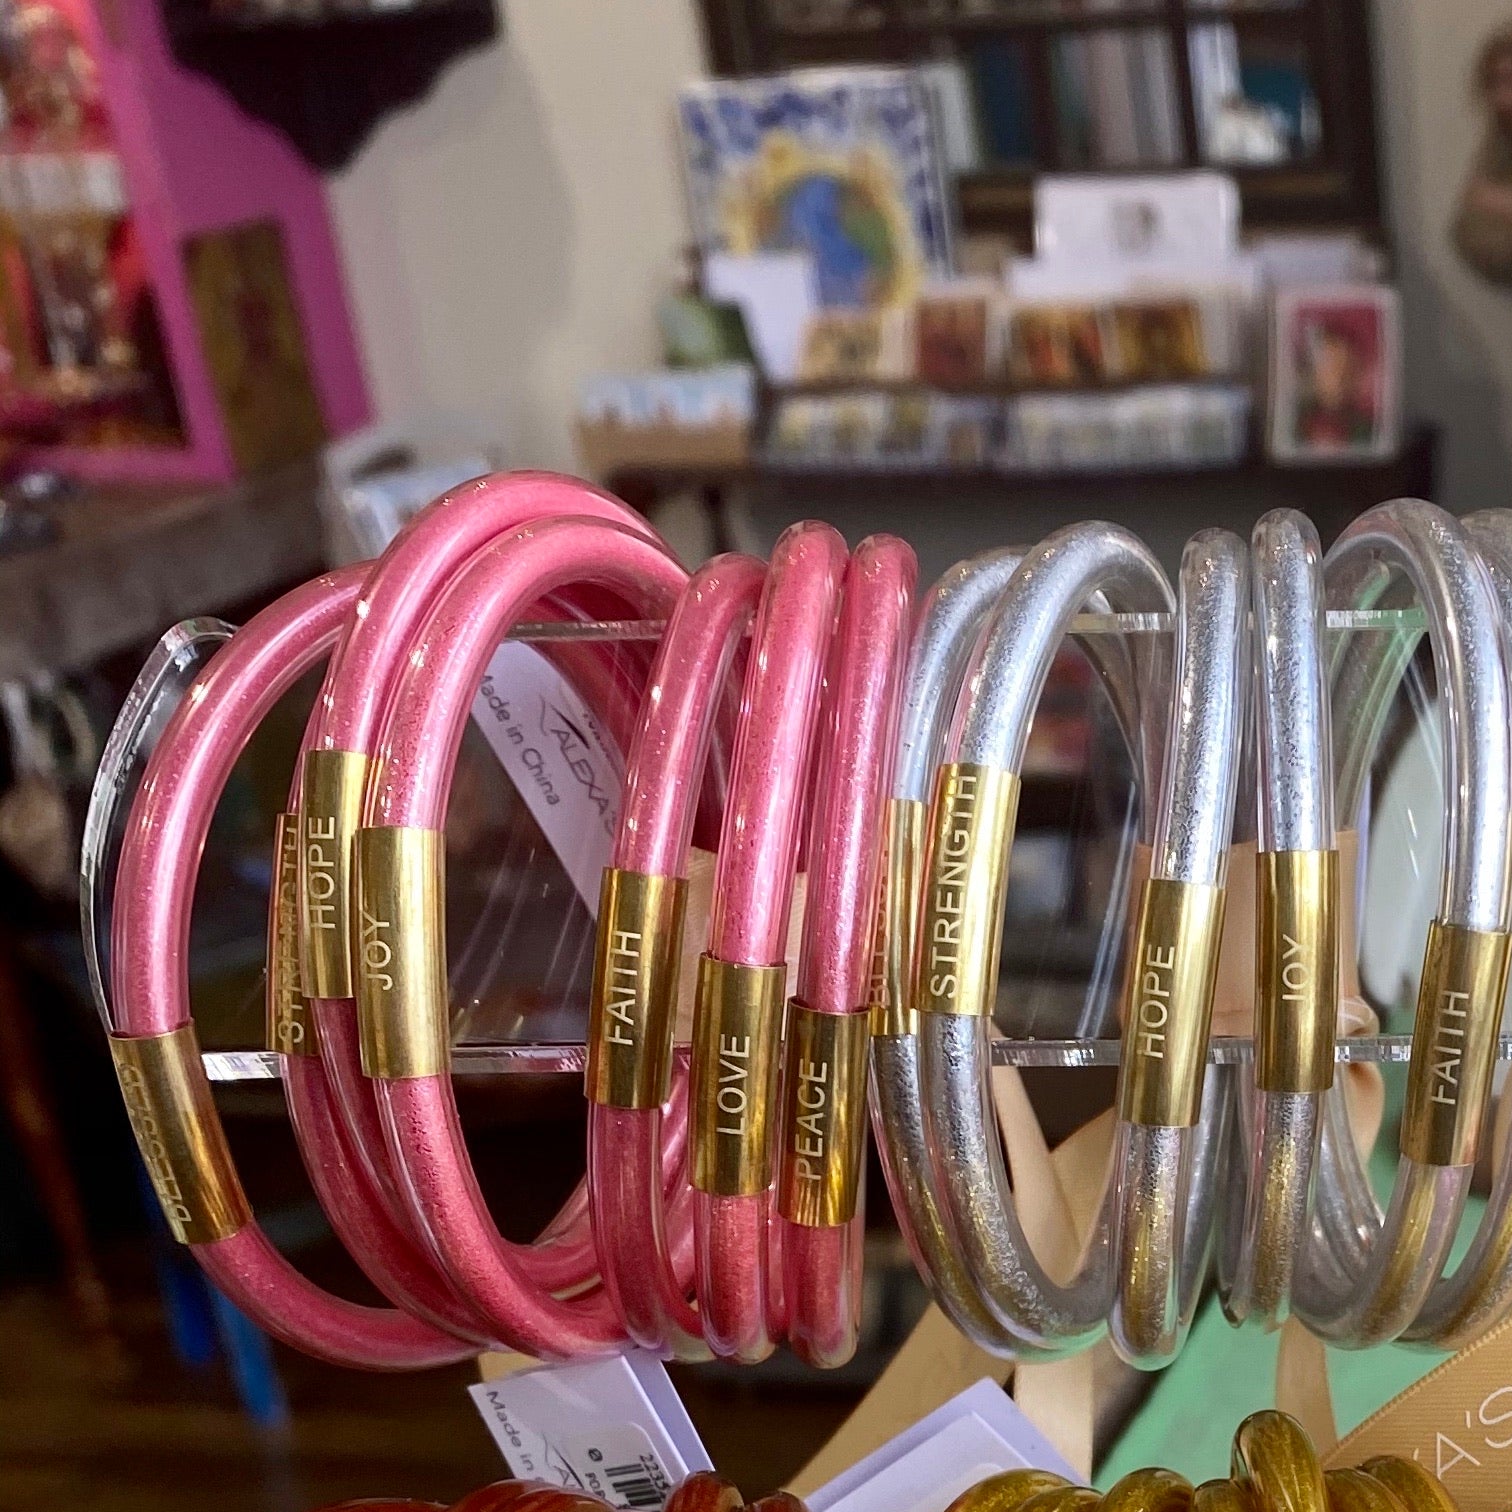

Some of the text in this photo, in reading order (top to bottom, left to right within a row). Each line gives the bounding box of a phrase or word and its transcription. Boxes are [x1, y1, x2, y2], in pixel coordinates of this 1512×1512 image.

[521, 747, 561, 807] China
[308, 815, 336, 929] HOPE
[929, 774, 978, 999] STRENGTH
[363, 909, 393, 992] JOY
[604, 930, 642, 1047] FAITH
[1137, 943, 1176, 1059] HOPE
[715, 1032, 751, 1136] LOVE
[1431, 990, 1470, 1105] FAITH
[794, 1058, 828, 1181] PEACE
[486, 1390, 536, 1472] Made in
